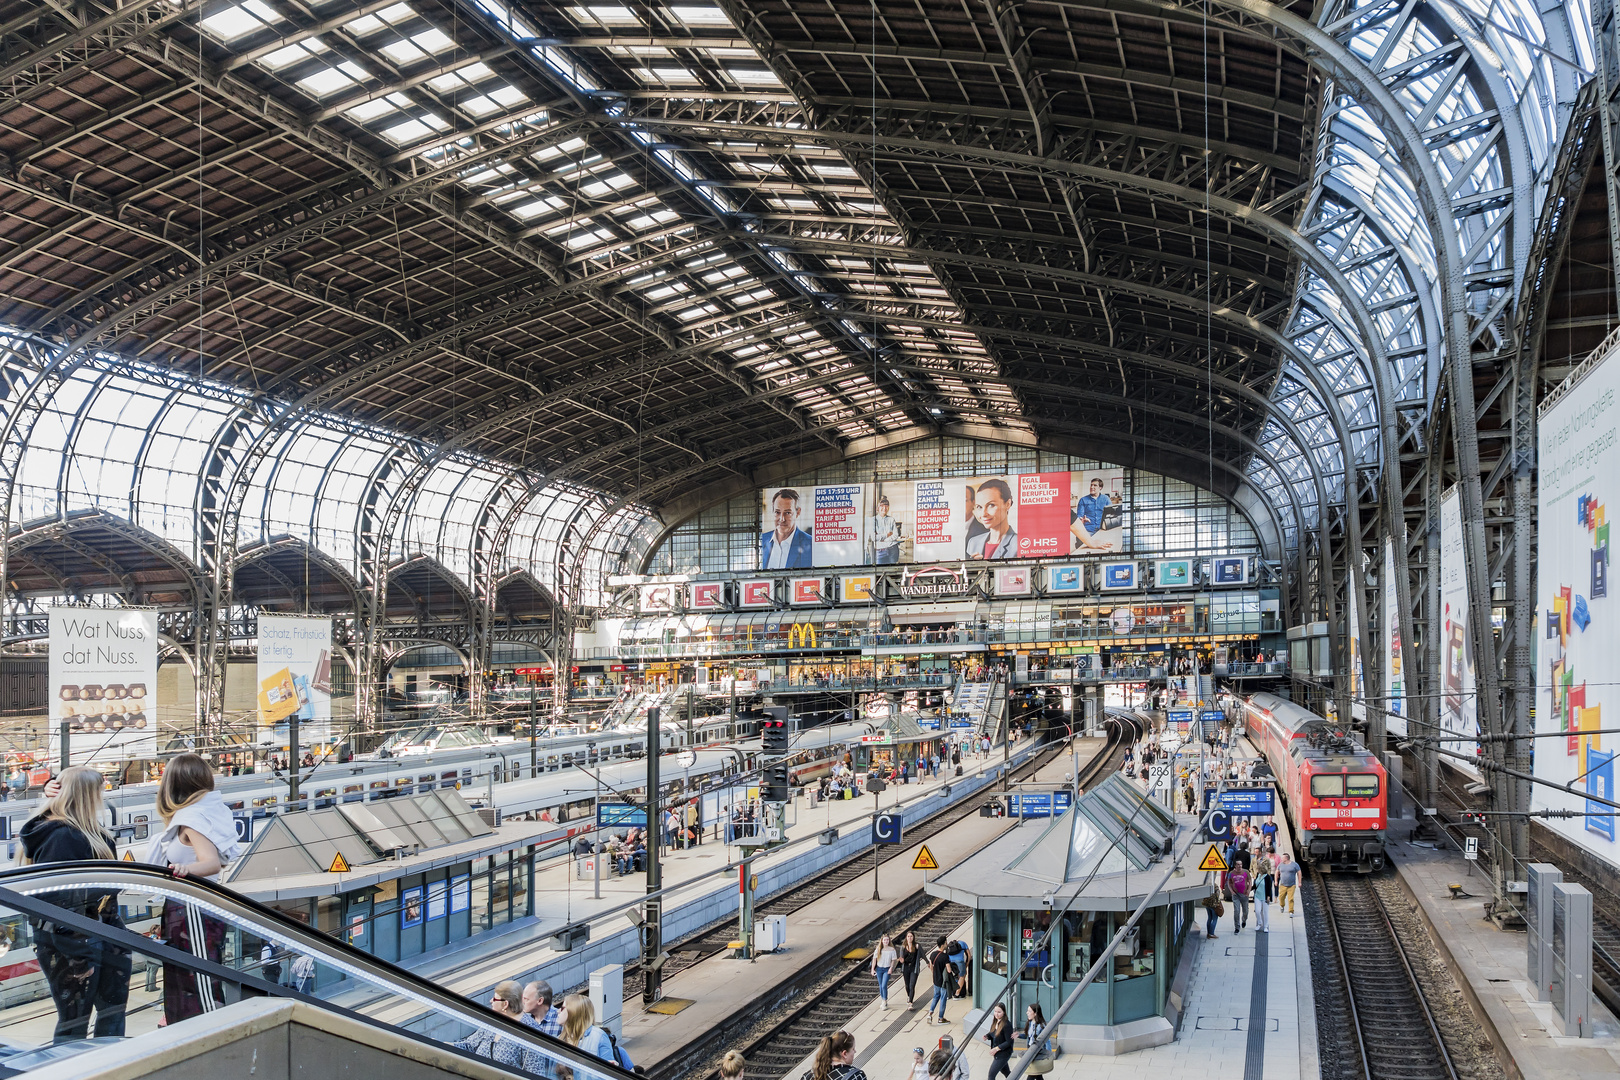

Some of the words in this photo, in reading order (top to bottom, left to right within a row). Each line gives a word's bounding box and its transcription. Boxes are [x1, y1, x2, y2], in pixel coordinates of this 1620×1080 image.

[1034, 538, 1057, 546] HRS
[901, 584, 969, 595] WANDELHALLE
[62, 618, 100, 638] Wat
[106, 620, 146, 642] Nuss,
[263, 626, 291, 640] Schatz,
[294, 627, 327, 639] Frühstück
[63, 644, 91, 664] dat
[97, 646, 138, 664] Nuss.
[273, 642, 294, 659] fertig.
[1151, 766, 1169, 776] 286
[235, 819, 245, 838] D
[876, 815, 892, 838] C
[1209, 811, 1226, 834] C
[1468, 839, 1476, 851] H
